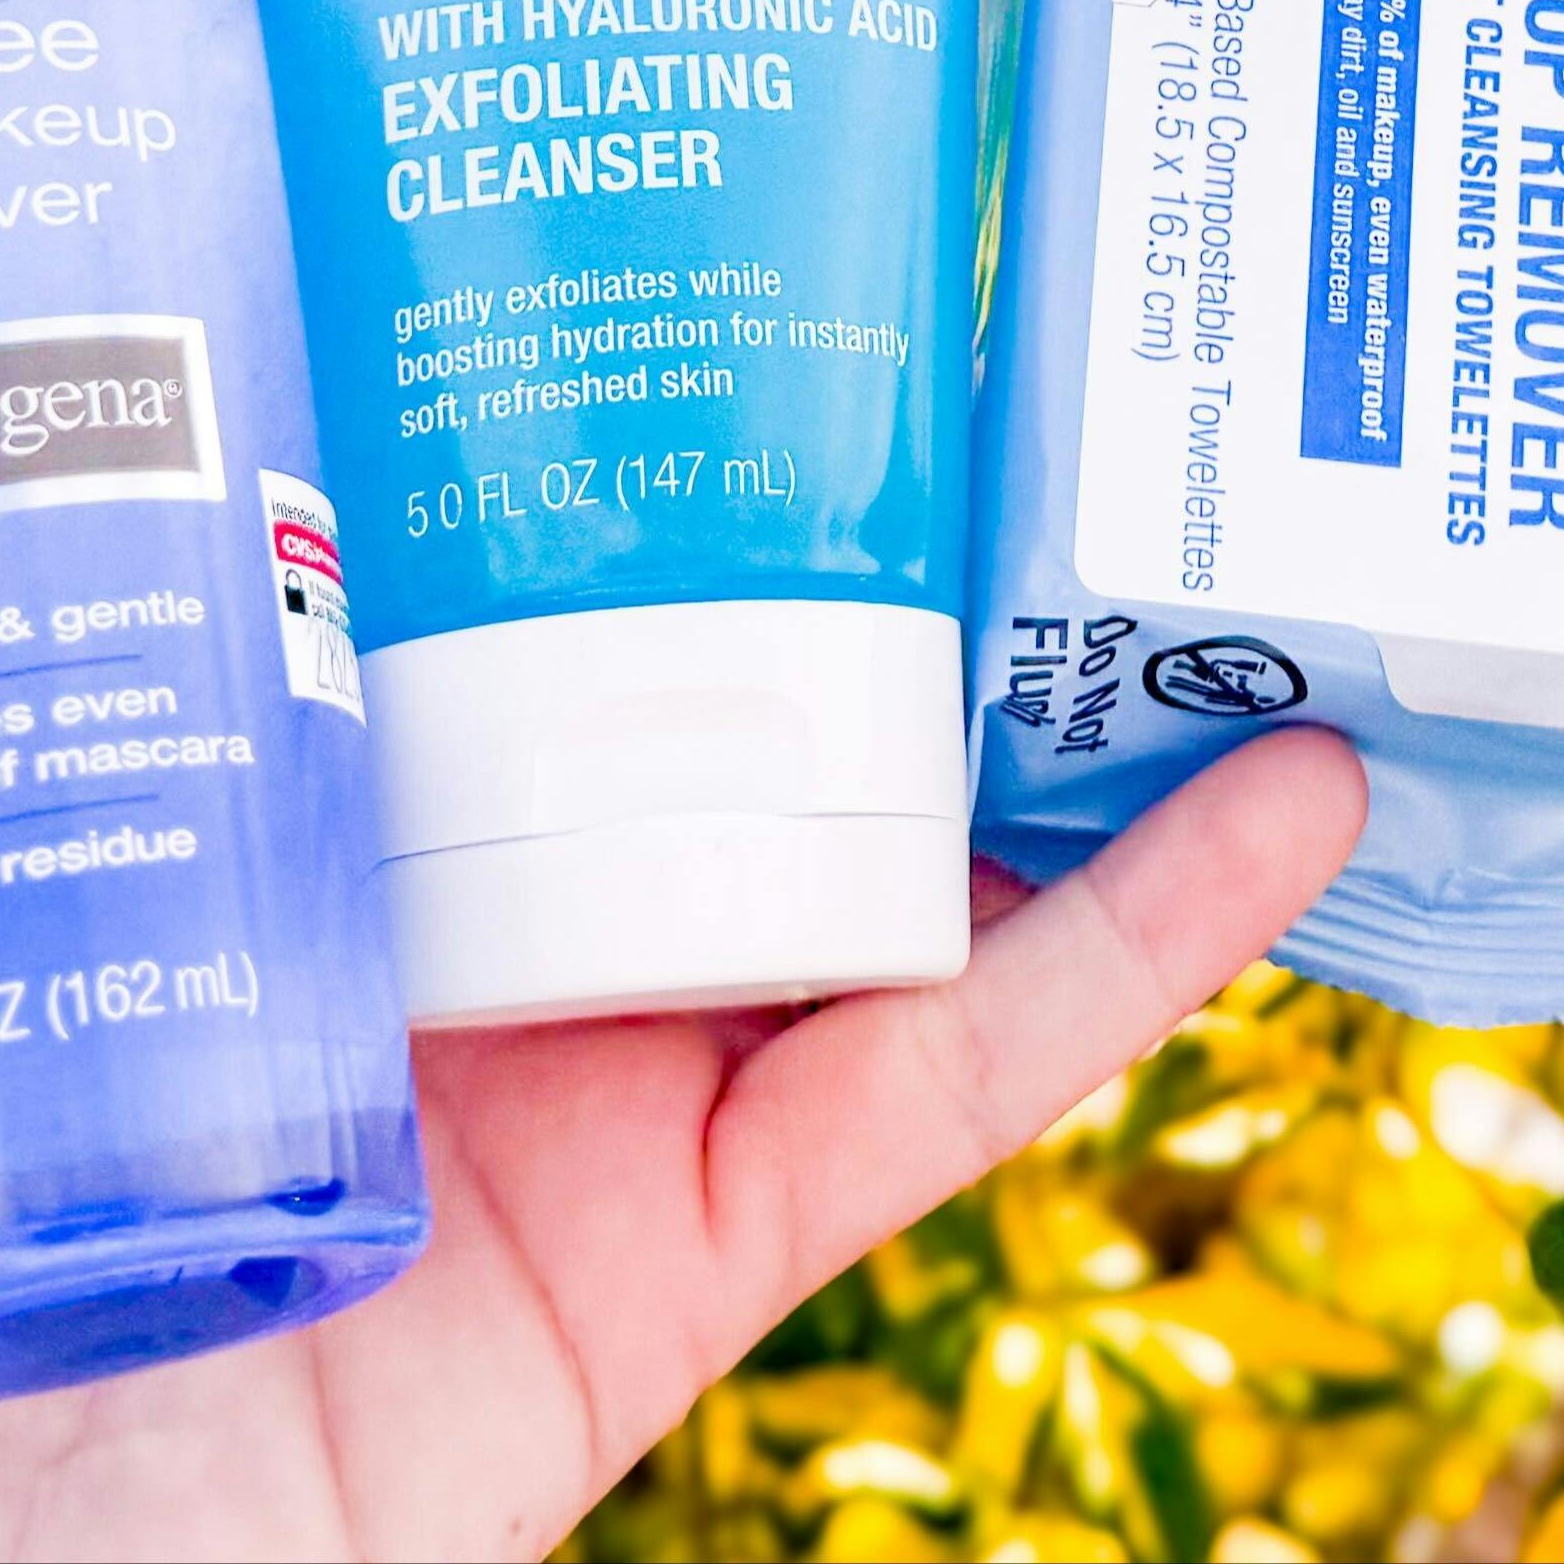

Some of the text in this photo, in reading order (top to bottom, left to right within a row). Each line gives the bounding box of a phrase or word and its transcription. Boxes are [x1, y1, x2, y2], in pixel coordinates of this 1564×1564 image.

[378, 6, 504, 61] WITH
[1335, 25, 1368, 79] dirt,
[1377, 30, 1404, 62] of
[382, 53, 794, 144] EXFOLIATING
[1151, 40, 1200, 141] (18.5
[1337, 87, 1363, 121] oil
[1366, 66, 1400, 188] makeup,
[1153, 151, 1184, 174] x
[1334, 125, 1361, 178] and
[1456, 17, 1503, 251] CLEANSING
[386, 129, 723, 223] CLEANSER
[1145, 190, 1190, 277] 16.5
[1193, 116, 1247, 364] Compostable
[1327, 182, 1354, 324] sunscreen
[1368, 196, 1392, 265] even
[394, 262, 782, 342] gently exfoliates while
[1131, 291, 1180, 363] cm)
[397, 311, 910, 386] boosting hydration for instantly
[1357, 273, 1392, 442] waterproof
[399, 363, 734, 439] soft, refreshed skin
[1446, 265, 1494, 547] TOWELETTES
[478, 471, 527, 524] FL
[541, 458, 600, 512] OZ
[615, 451, 706, 512] (147
[724, 449, 797, 507] mL)
[1182, 380, 1233, 592] Towelettes
[51, 590, 206, 644] gentle
[51, 686, 178, 727] even
[1054, 614, 1138, 754] Do Not
[35, 732, 255, 783] mascara
[0, 826, 198, 884] residue
[46, 959, 166, 1040] (162
[175, 951, 260, 1018] mL)
